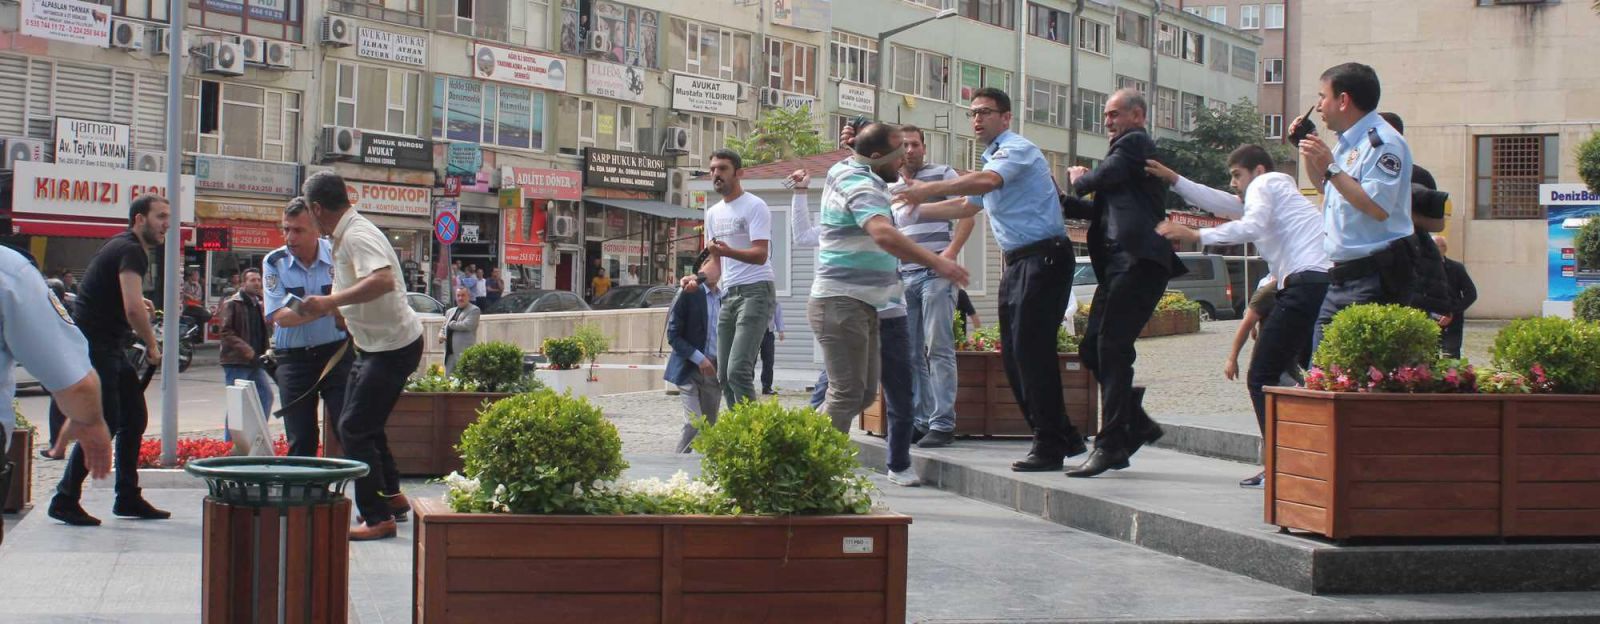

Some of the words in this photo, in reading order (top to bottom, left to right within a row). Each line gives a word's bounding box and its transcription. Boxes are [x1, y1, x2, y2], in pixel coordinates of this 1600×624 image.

[361, 29, 391, 42] AVUKAT
[396, 34, 425, 47] AVUKAT
[691, 80, 721, 91] AVUKAT
[675, 87, 703, 98] Mustafa
[704, 91, 736, 102] YILDIRIM
[71, 120, 116, 142] yaman
[59, 138, 71, 153] Av.
[74, 140, 97, 158] Teyfik
[99, 142, 126, 159] YAMAN
[373, 138, 396, 147] HUKUK
[367, 146, 394, 157] AVUKAT
[591, 152, 611, 164] SARP
[611, 154, 637, 168] HUKUK
[638, 156, 665, 170] BÜROSU
[517, 172, 545, 186] ADLİYE
[545, 174, 571, 188] DÖNER
[35, 177, 119, 204] KIRMIZI
